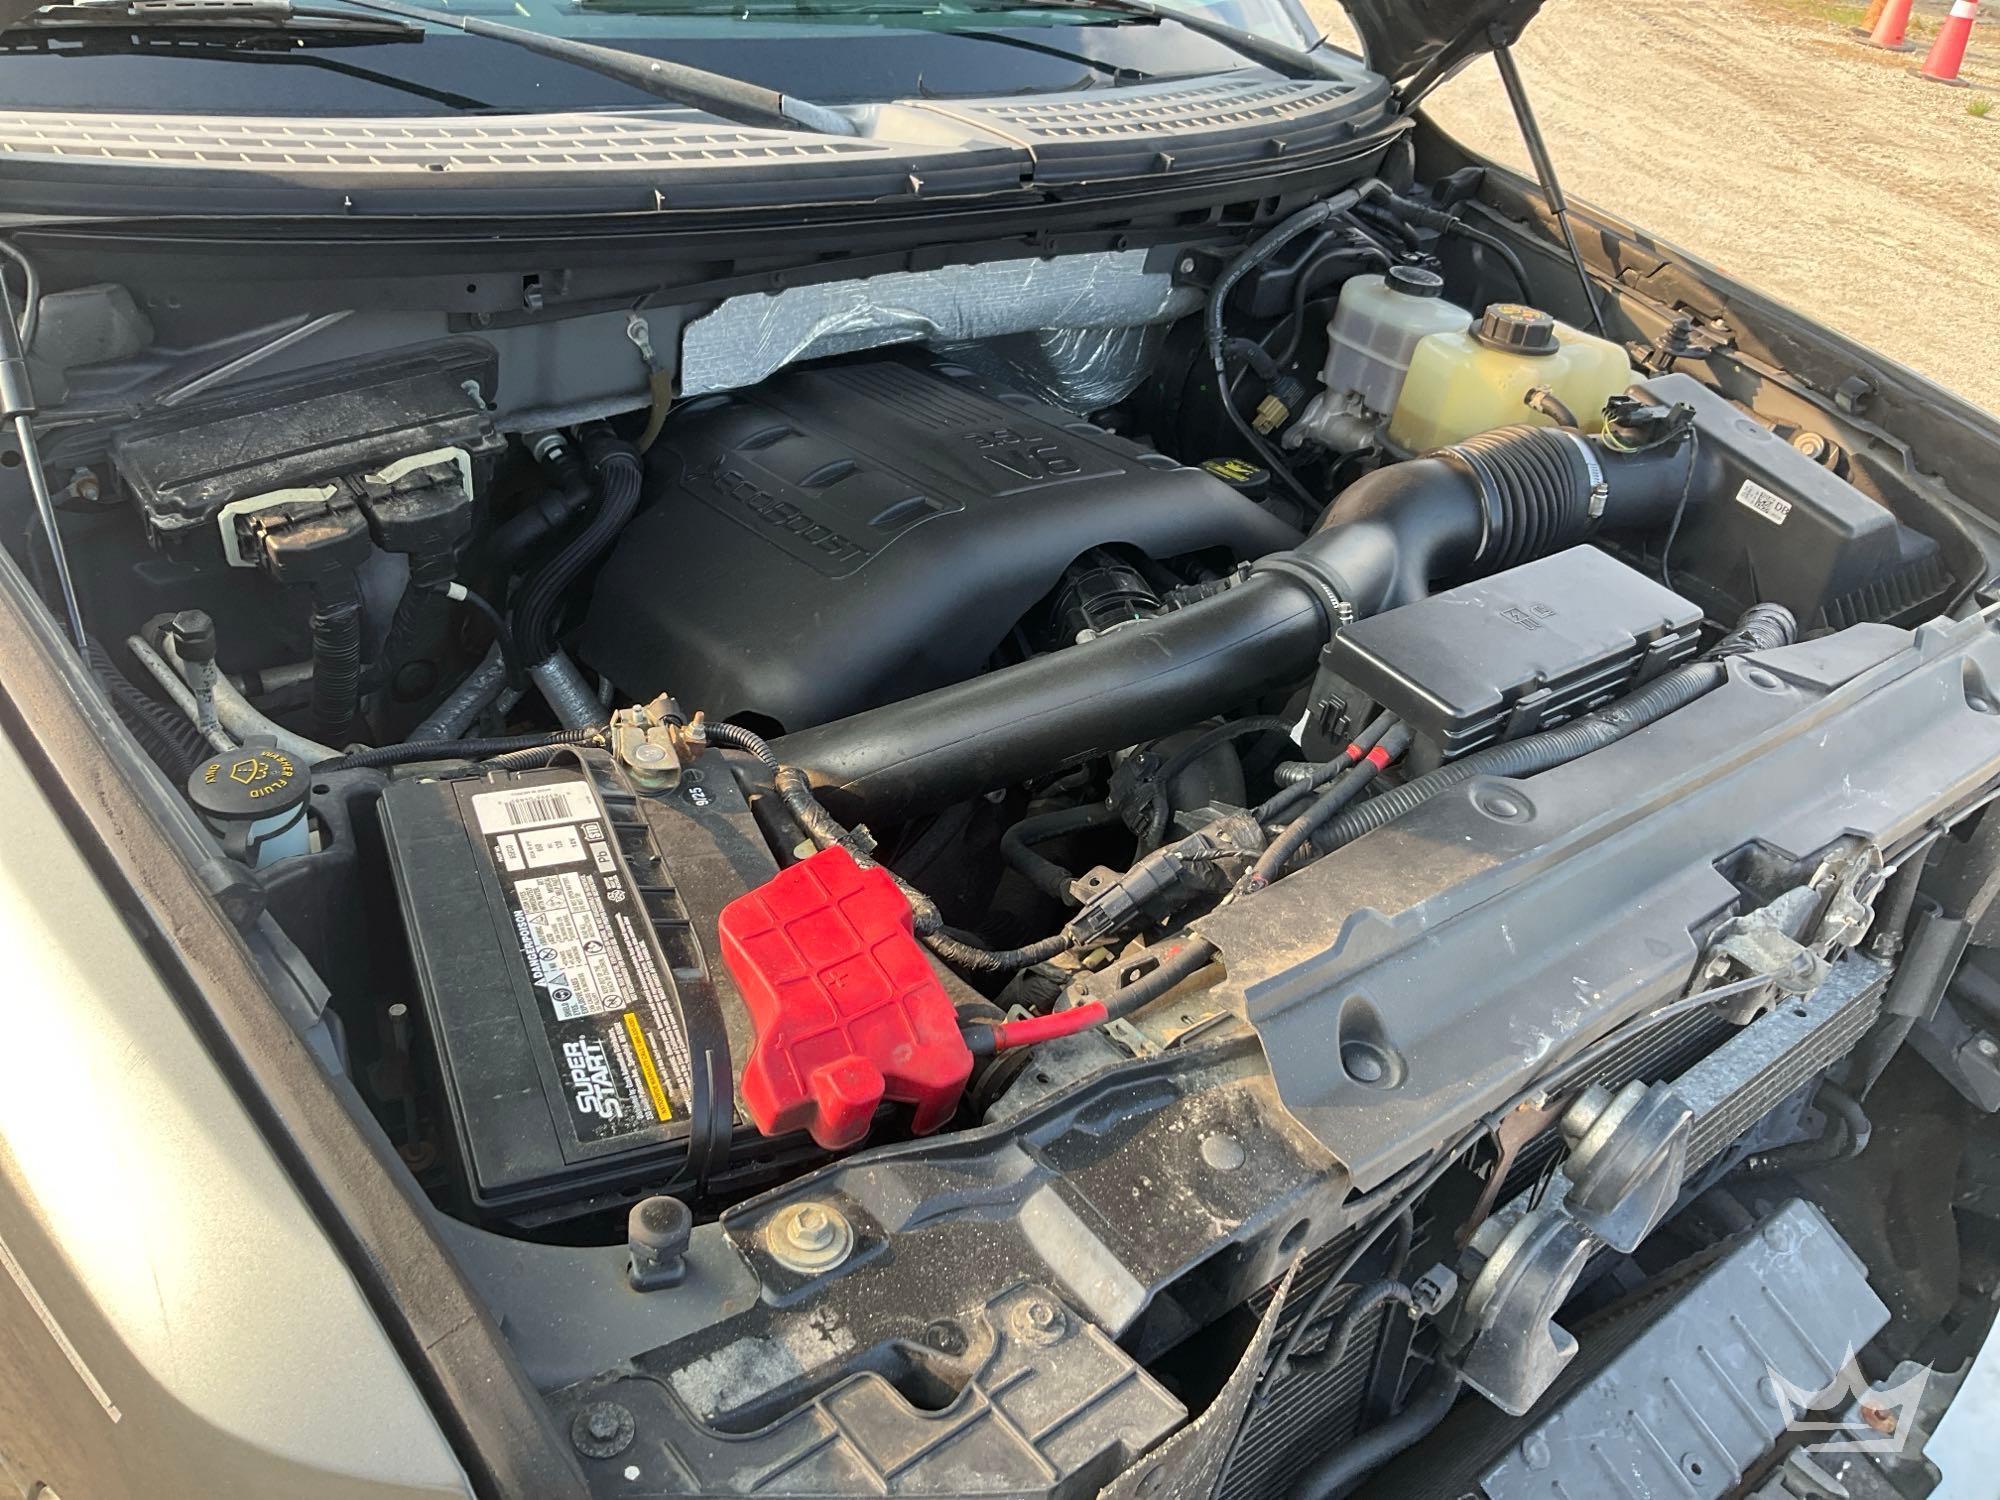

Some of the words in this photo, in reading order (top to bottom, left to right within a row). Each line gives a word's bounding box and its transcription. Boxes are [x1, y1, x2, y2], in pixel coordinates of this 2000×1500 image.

[982, 444, 1081, 480] V6
[204, 763, 222, 784] ONLY
[261, 751, 294, 777] WASHER
[250, 779, 288, 798] FLUID
[688, 787, 709, 807] 9/25
[595, 850, 610, 863] Pb
[513, 910, 545, 979] DANGER/POISON
[562, 1042, 599, 1113] SUPER
[579, 1039, 623, 1118] START
